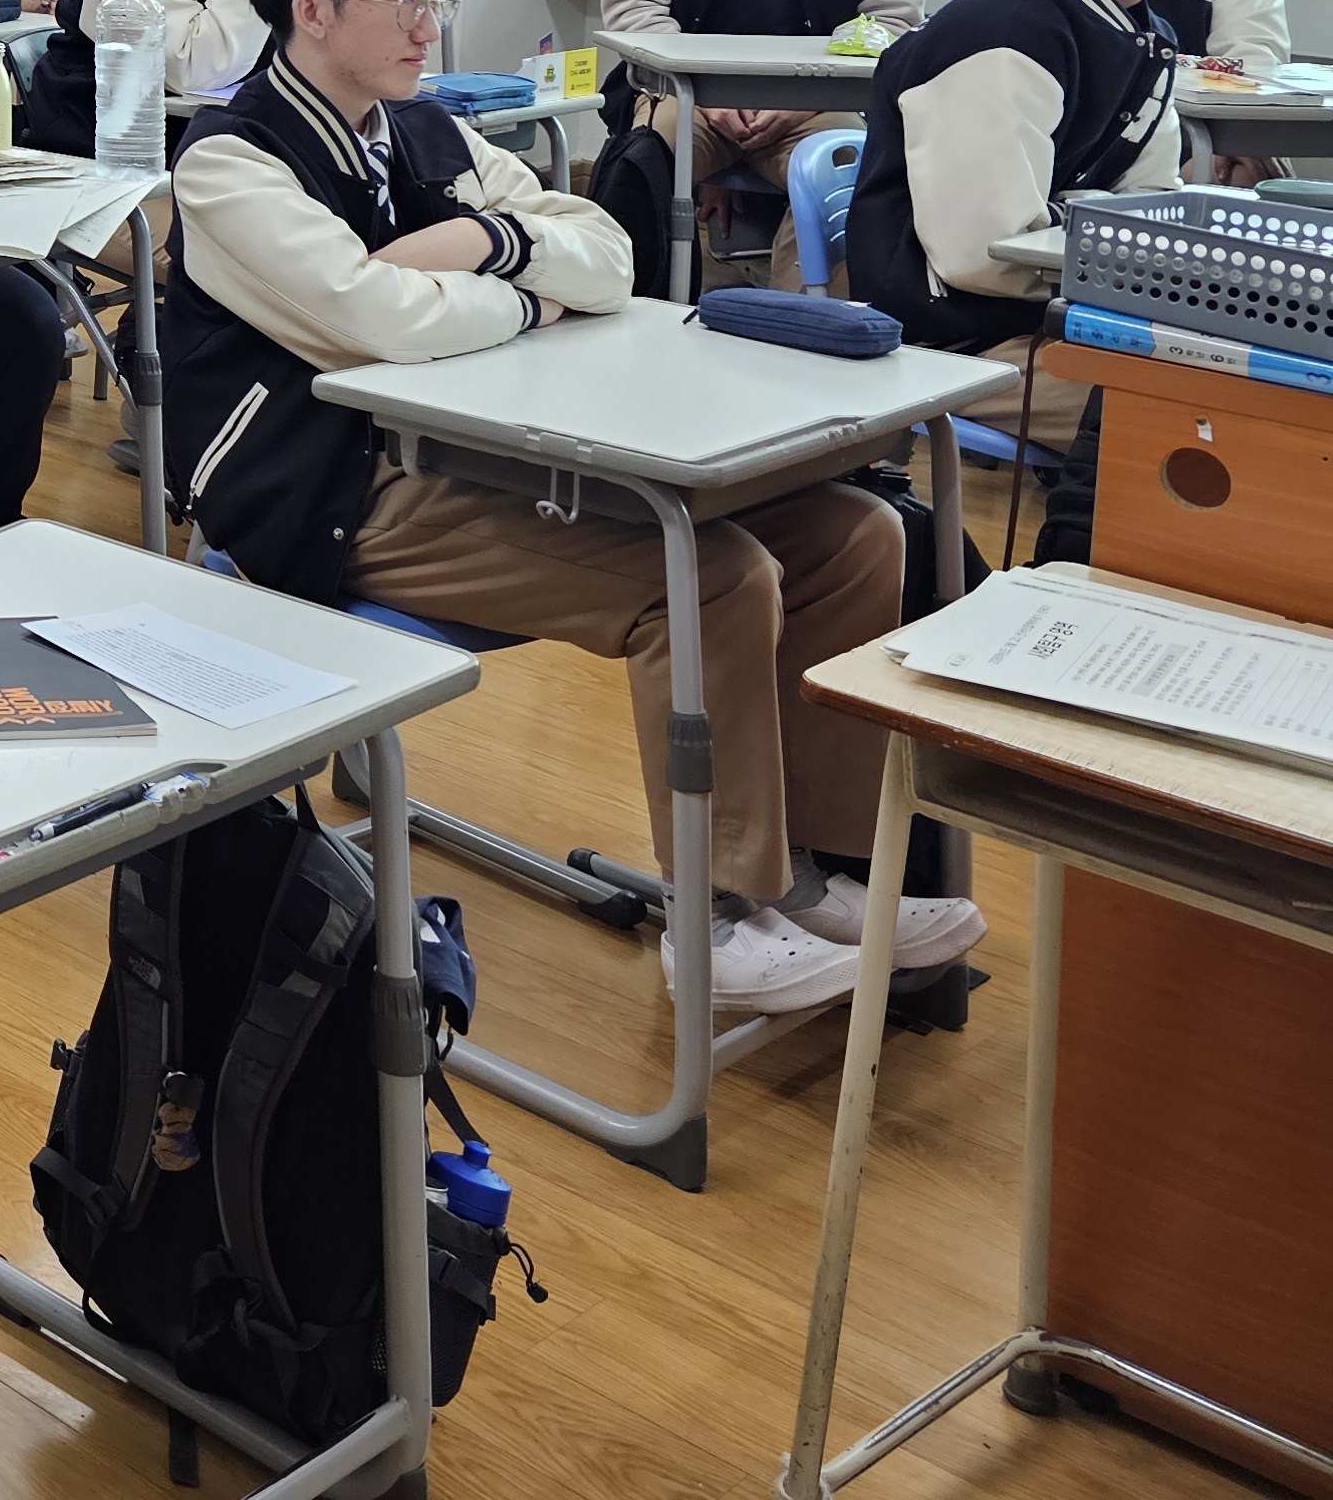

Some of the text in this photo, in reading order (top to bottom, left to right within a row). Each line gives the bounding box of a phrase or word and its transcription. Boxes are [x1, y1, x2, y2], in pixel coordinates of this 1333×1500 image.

[1027, 620, 1080, 660] 사회탐구 영역
[0, 687, 56, 725] WORK
